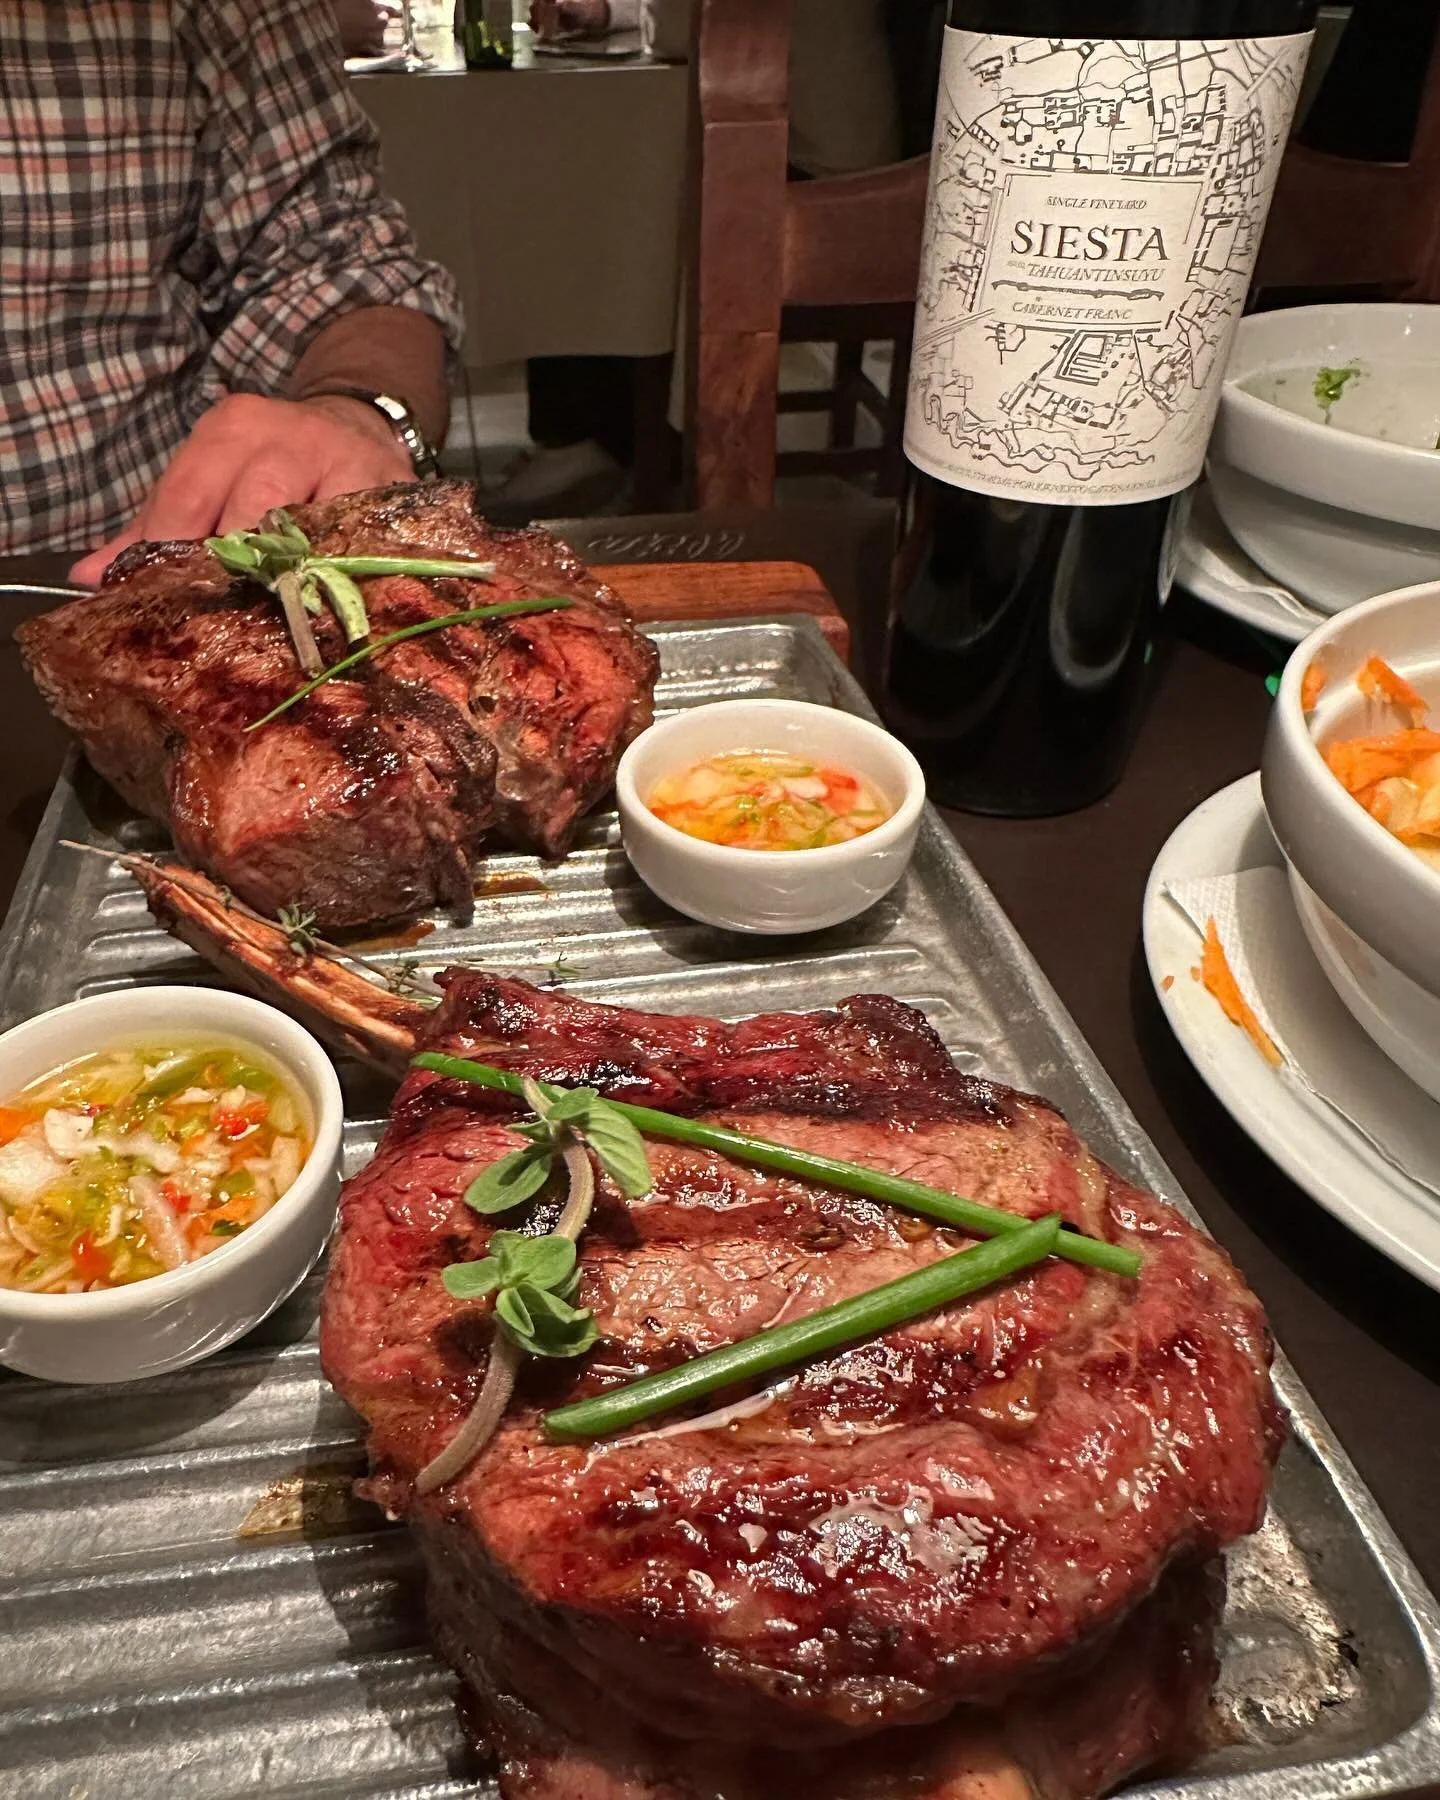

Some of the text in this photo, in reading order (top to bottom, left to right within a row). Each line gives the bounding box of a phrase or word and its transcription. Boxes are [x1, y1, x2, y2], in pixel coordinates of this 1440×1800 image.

[1047, 196, 1089, 209] SINGLE
[1011, 219, 1170, 262] SIESTA
[1027, 262, 1165, 282] TAHUANTINSUYU
[1012, 301, 1133, 320] CABERNET FRANC
